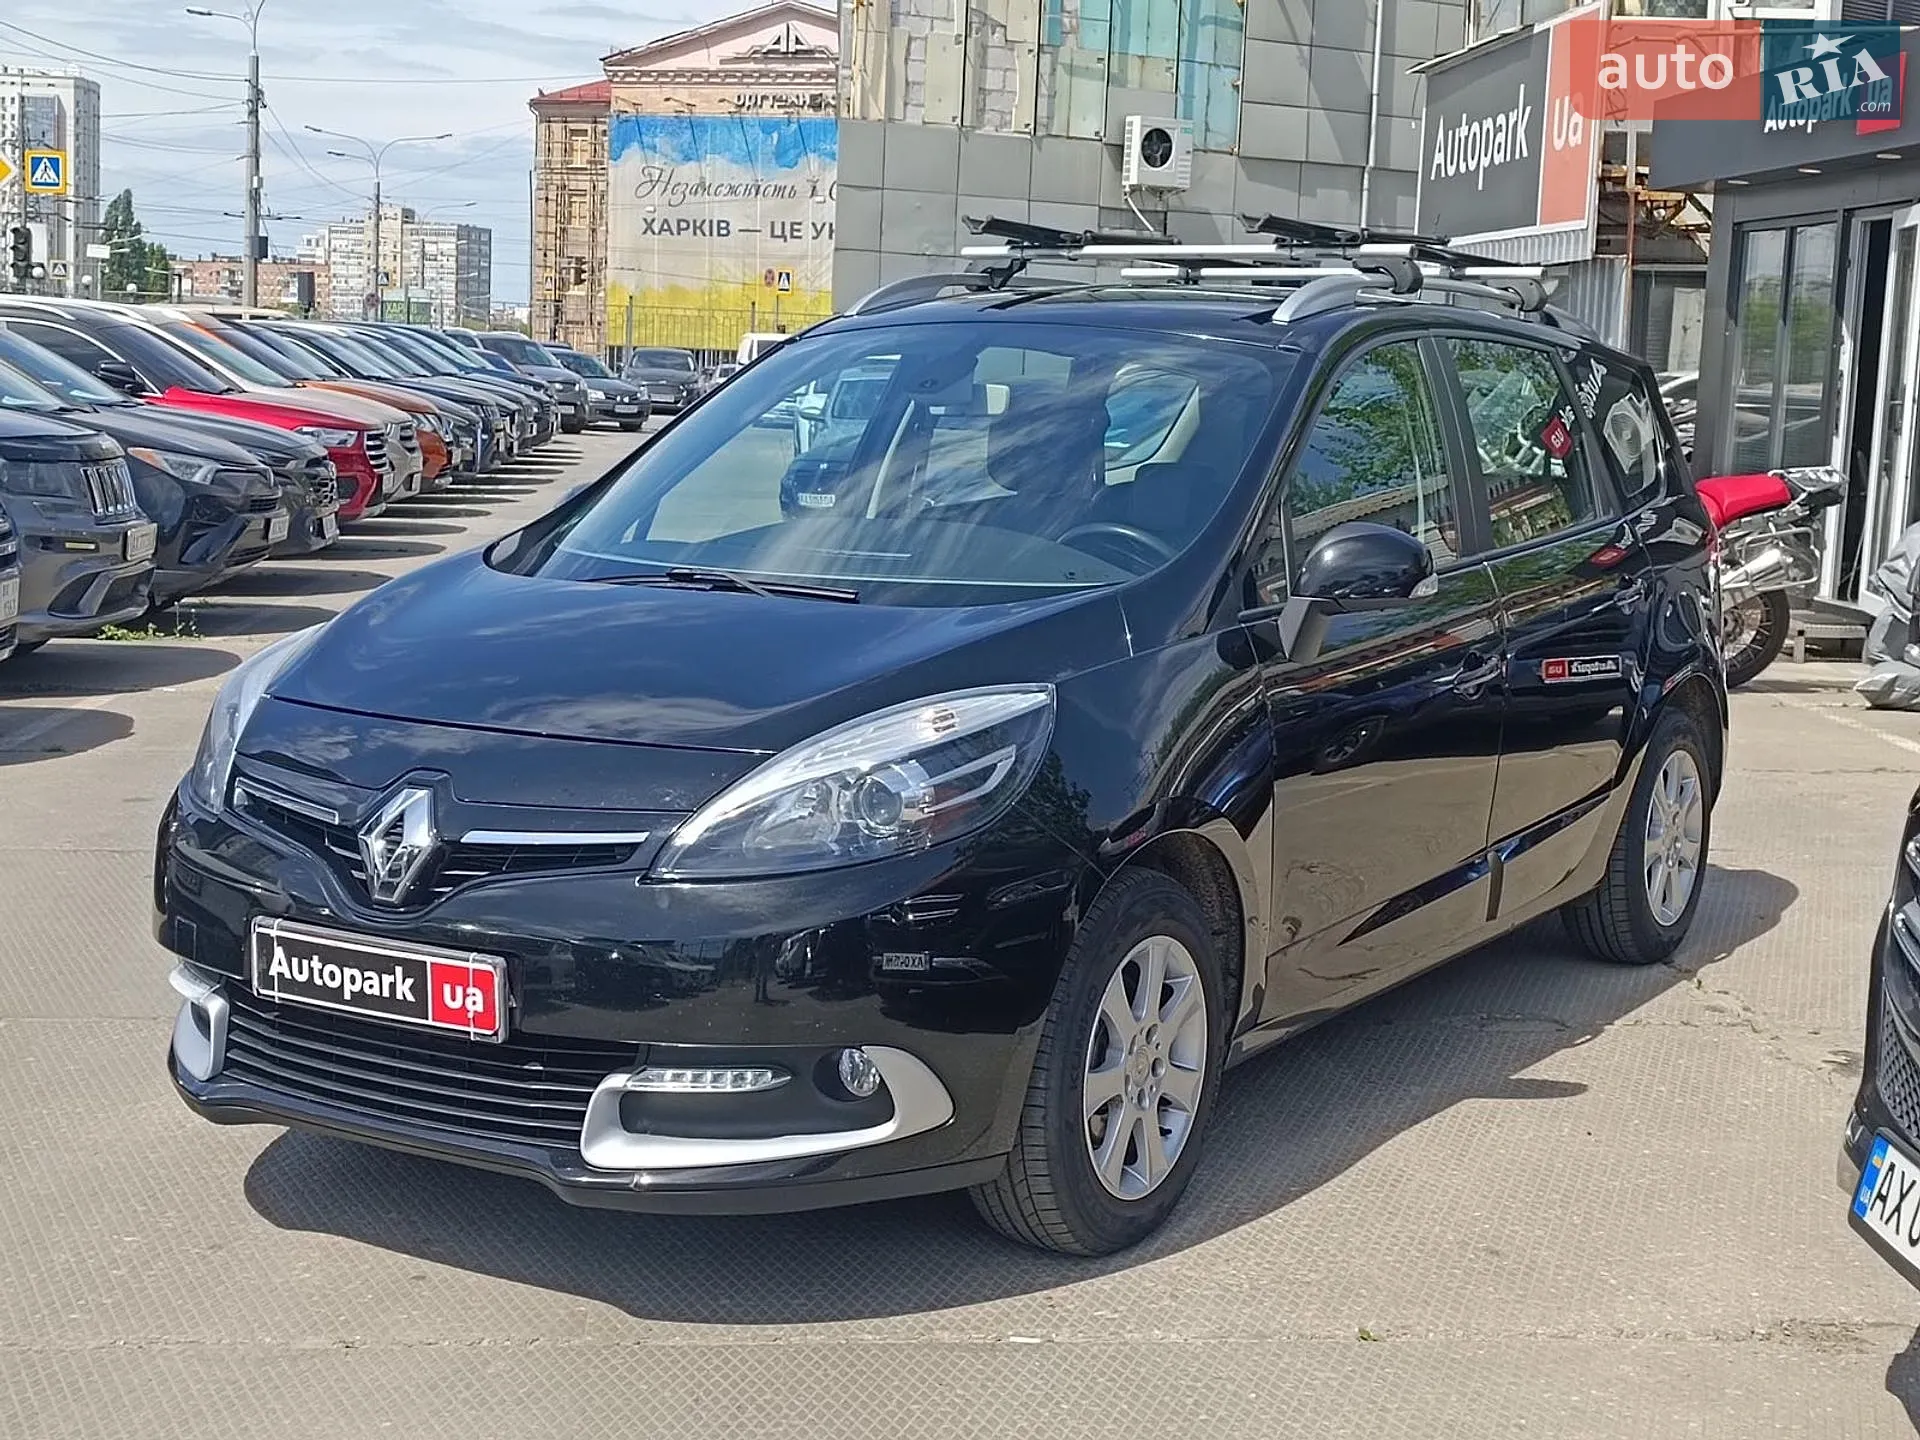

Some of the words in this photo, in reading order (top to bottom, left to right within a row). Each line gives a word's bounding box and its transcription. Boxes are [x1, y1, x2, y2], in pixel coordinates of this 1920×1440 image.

[1430, 83, 1532, 191] Autopark
[641, 217, 731, 237] ХАРКІВ
[770, 220, 803, 243] ЦЕ
[269, 946, 416, 1002] Autopark
